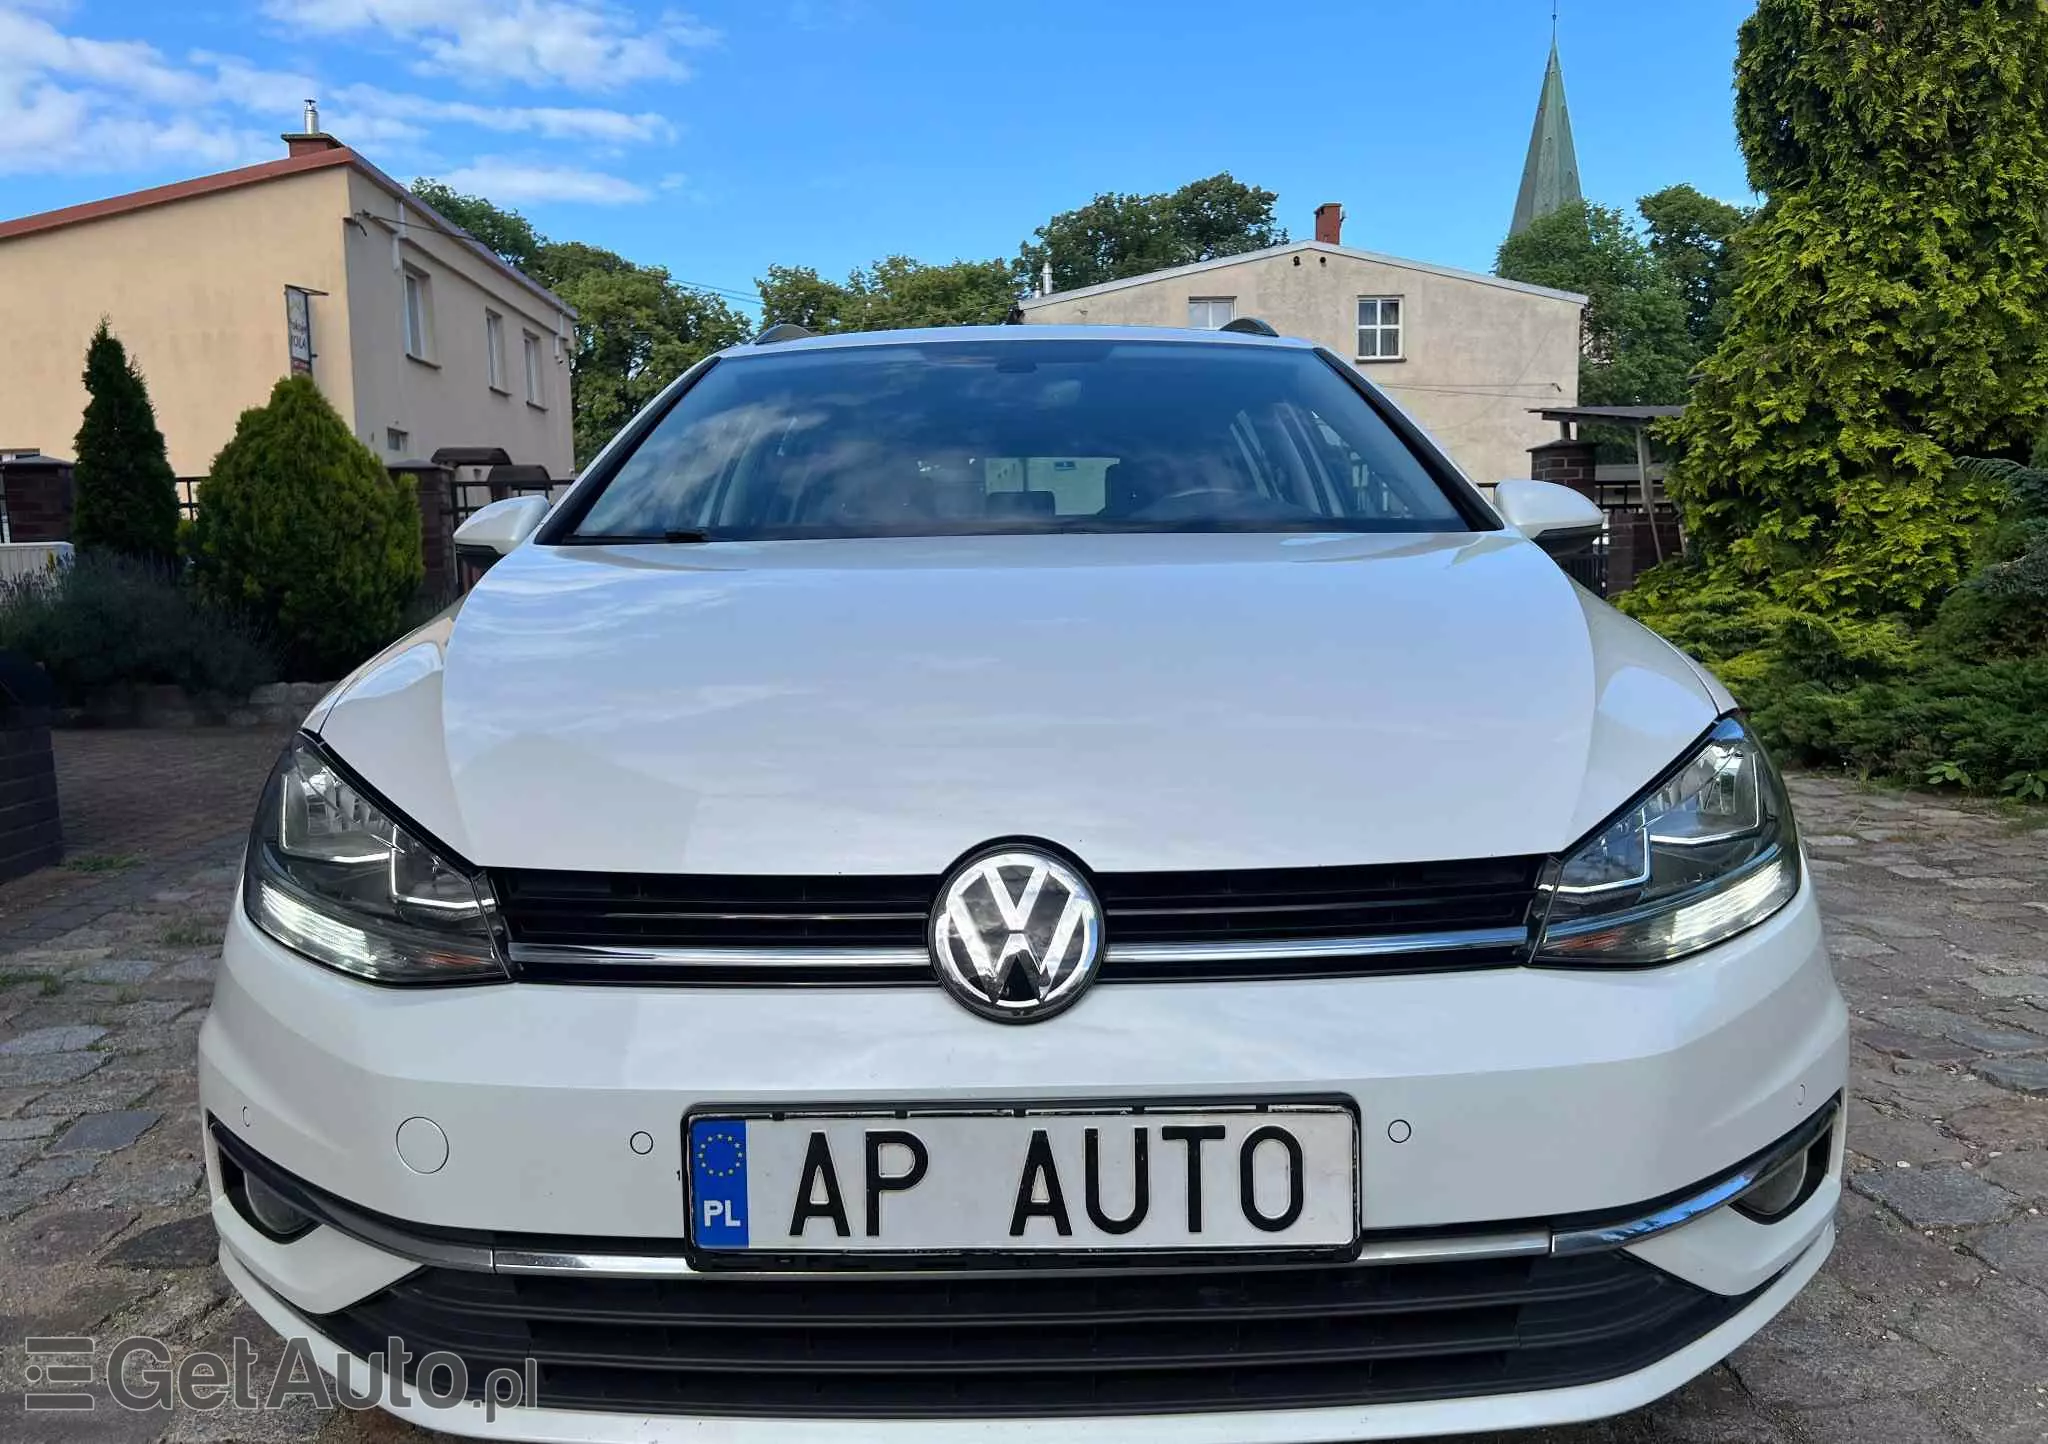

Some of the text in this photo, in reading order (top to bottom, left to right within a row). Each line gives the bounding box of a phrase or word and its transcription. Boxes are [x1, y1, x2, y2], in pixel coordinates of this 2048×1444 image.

[938, 854, 1098, 1005] VW
[703, 1199, 741, 1227] PL
[788, 1123, 1304, 1238] AP AUTO
